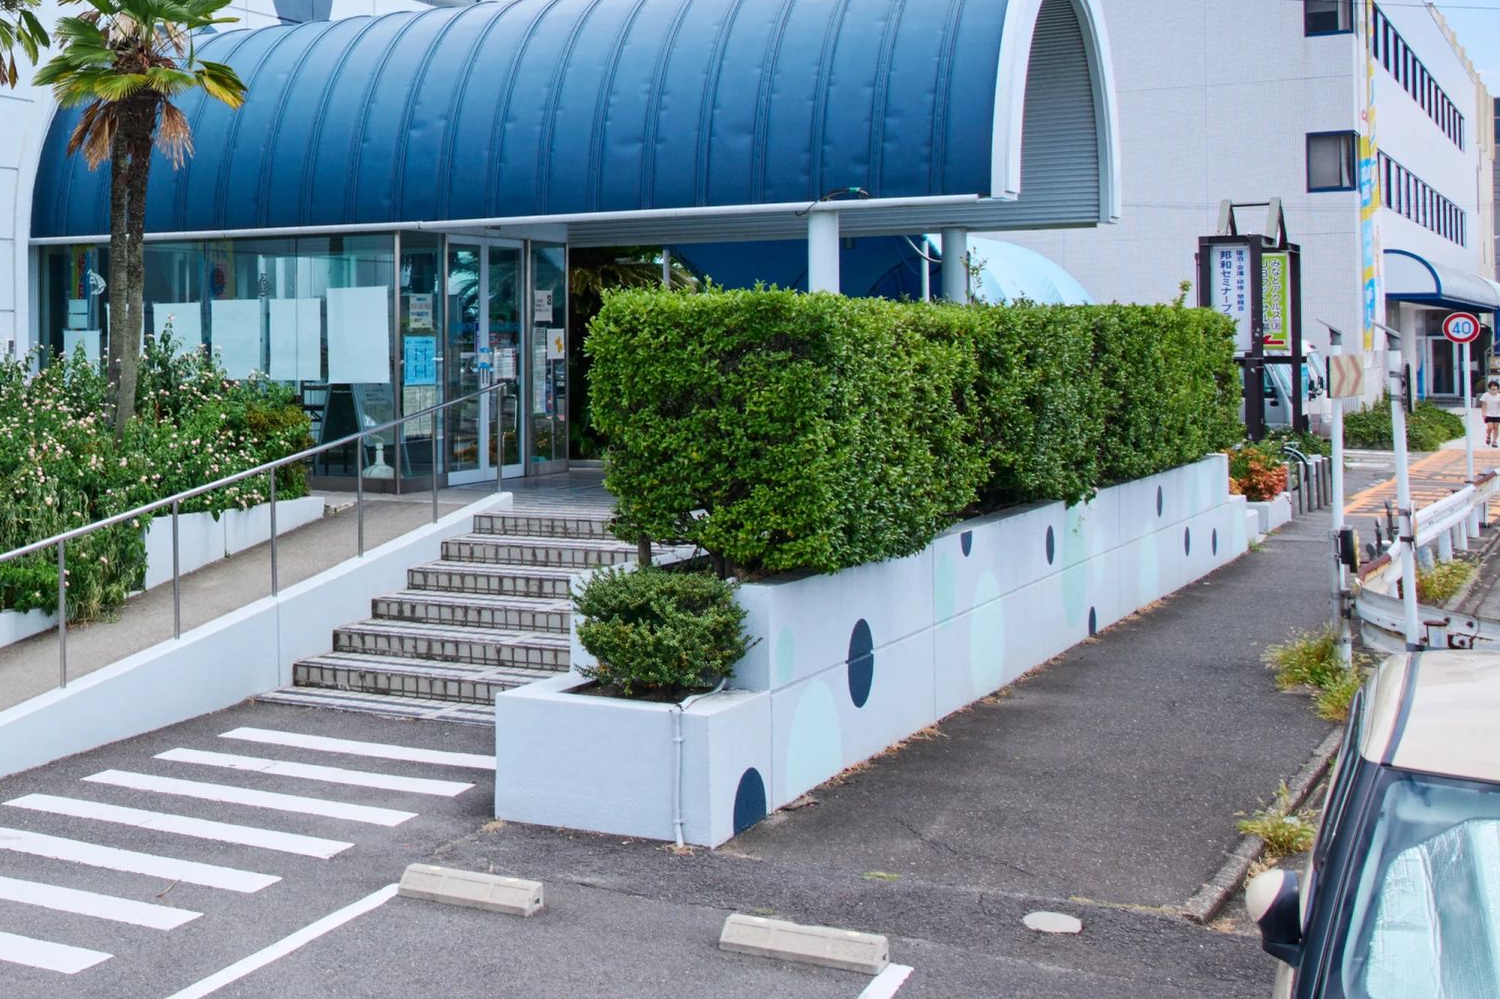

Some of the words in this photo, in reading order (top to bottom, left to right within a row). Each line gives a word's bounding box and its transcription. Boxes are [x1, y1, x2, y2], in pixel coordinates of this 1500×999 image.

[1219, 250, 1233, 317] 邦和セミナープ
[1451, 321, 1472, 335] 40
